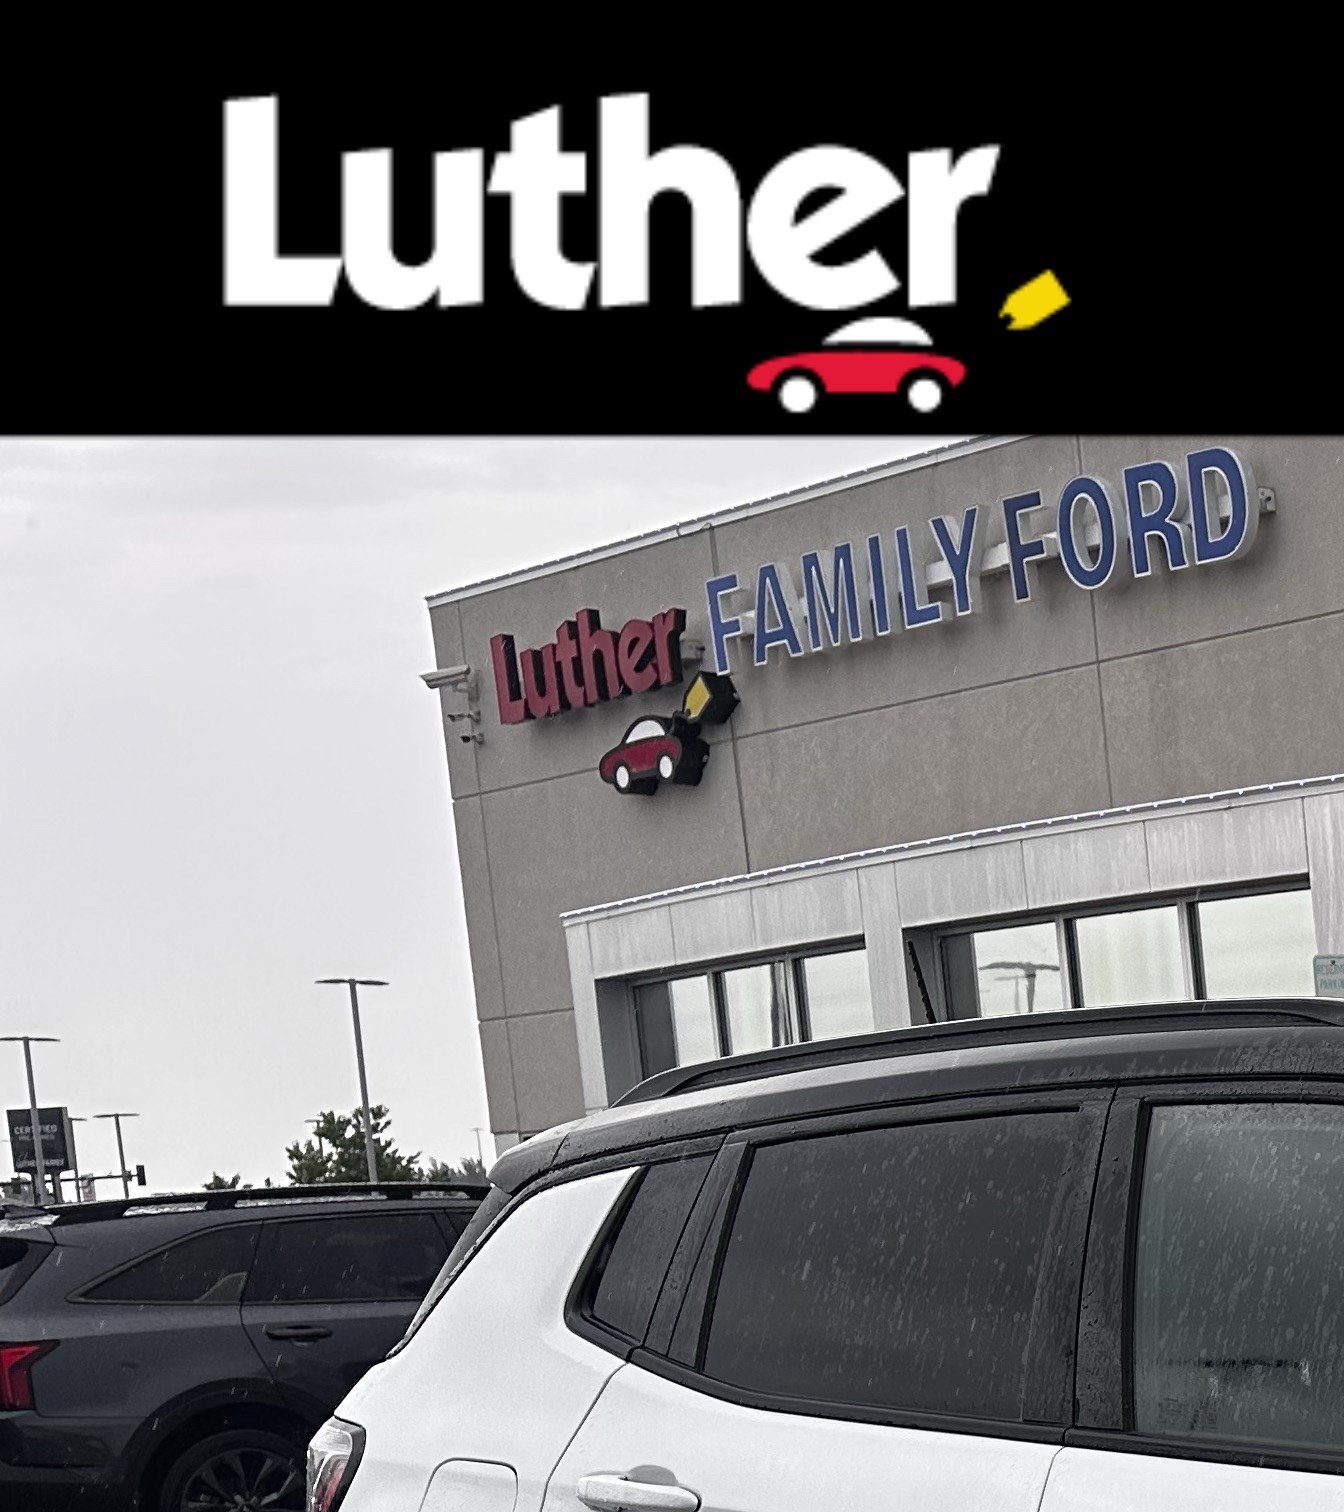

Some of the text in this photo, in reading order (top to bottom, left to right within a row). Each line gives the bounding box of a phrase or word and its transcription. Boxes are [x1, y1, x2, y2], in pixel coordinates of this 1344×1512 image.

[705, 447, 1256, 675] FAMILY FORD
[490, 607, 687, 725] Luther
